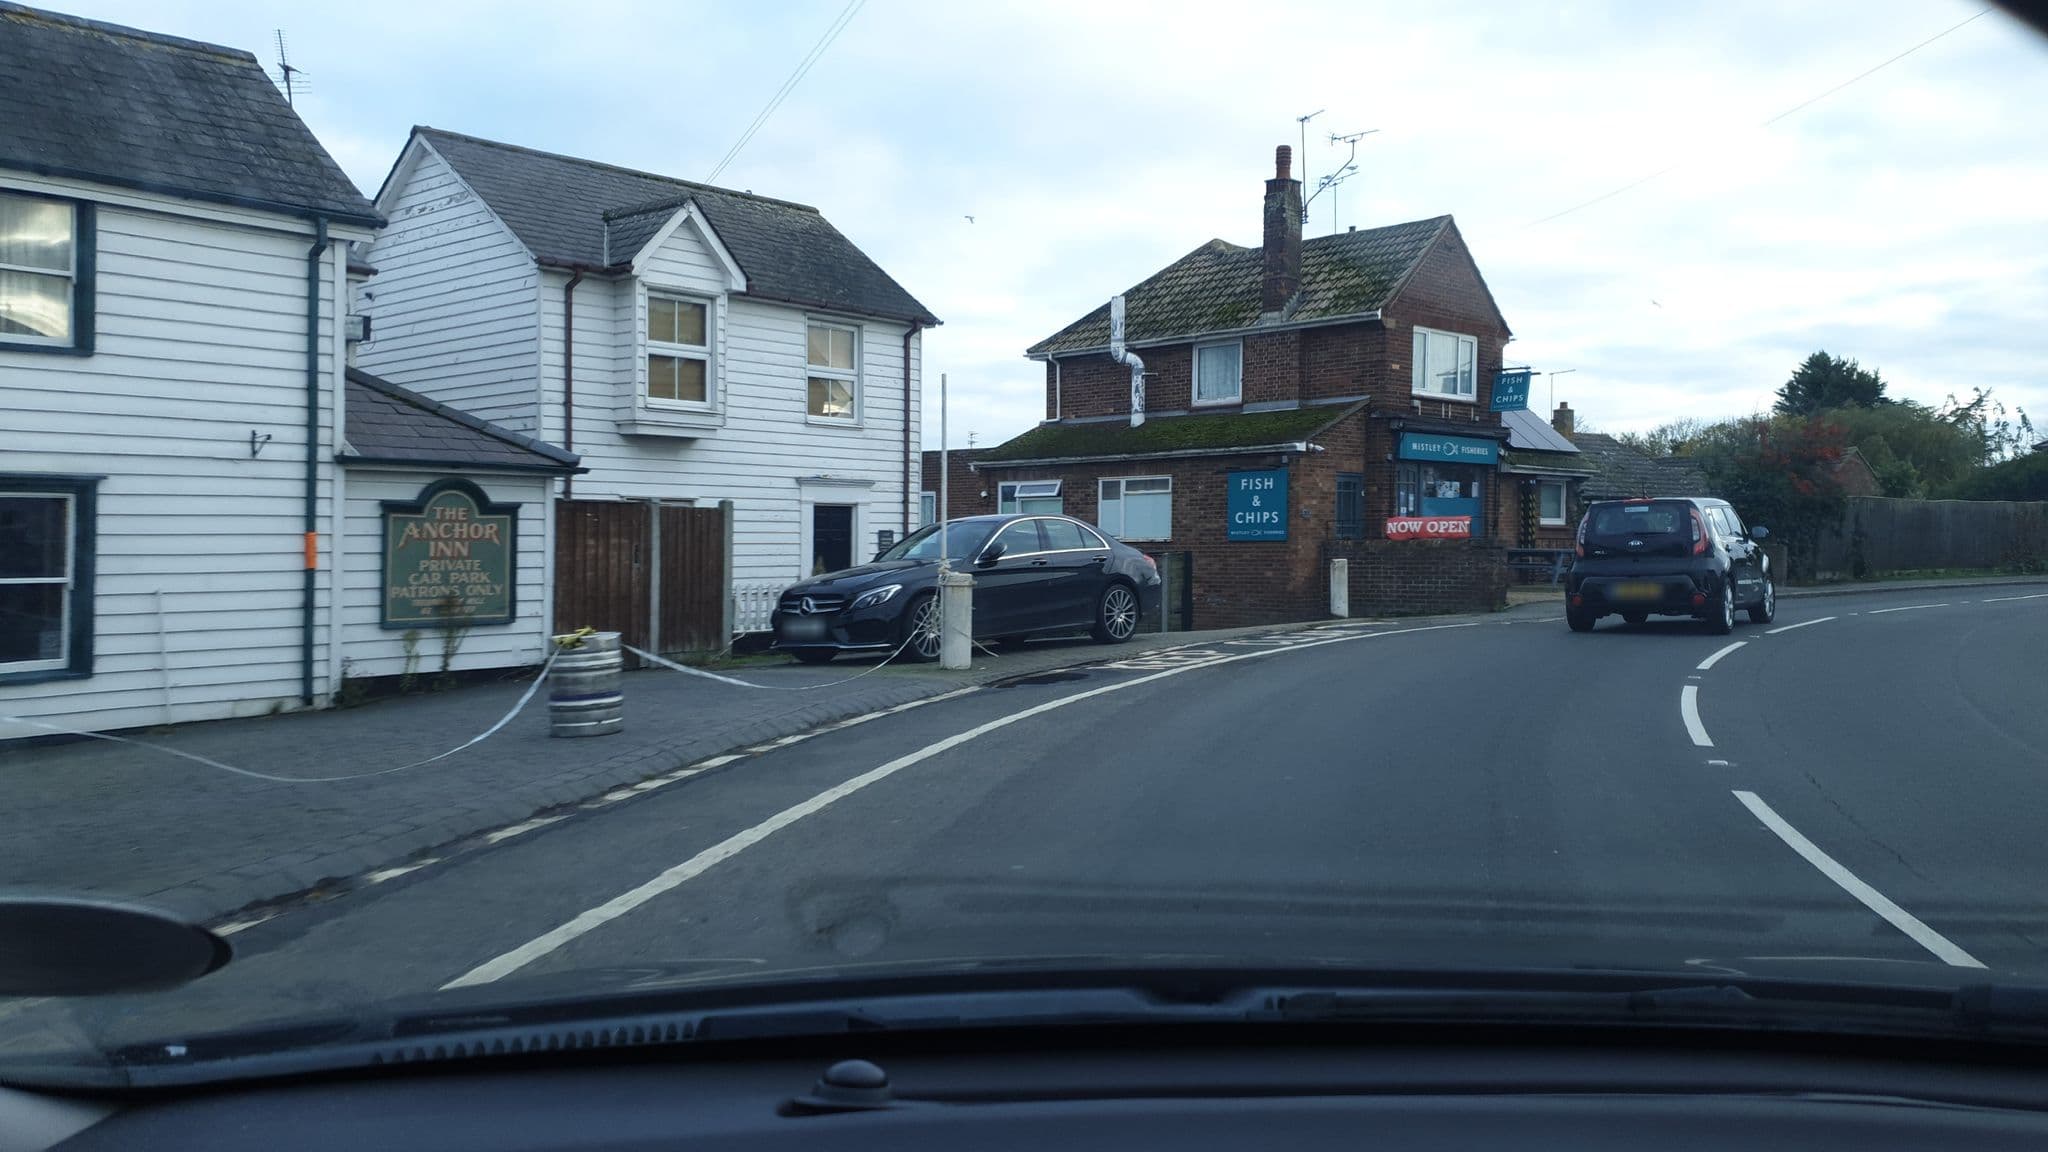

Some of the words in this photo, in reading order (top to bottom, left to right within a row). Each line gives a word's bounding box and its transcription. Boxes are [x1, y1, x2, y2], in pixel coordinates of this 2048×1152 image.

[1501, 376, 1523, 385] FISH
[1495, 394, 1524, 404] CHIPS
[1411, 442, 1441, 452] MISTLEY
[1461, 446, 1489, 456] FISHERIES
[1240, 477, 1274, 490] FISH
[1252, 495, 1261, 507] &
[432, 507, 469, 520] THE
[1235, 511, 1279, 524] CHIPS
[1386, 521, 1423, 534] NOW
[1426, 521, 1471, 533] OPEN
[398, 521, 500, 549] ANCHOR
[429, 541, 469, 557] INN
[419, 559, 481, 571] PRIVATE
[408, 572, 441, 585] CAR
[449, 571, 491, 583] PARK
[391, 585, 460, 598] PATRONS
[465, 583, 503, 596] ONLY
[1086, 649, 1235, 670] KEEP
